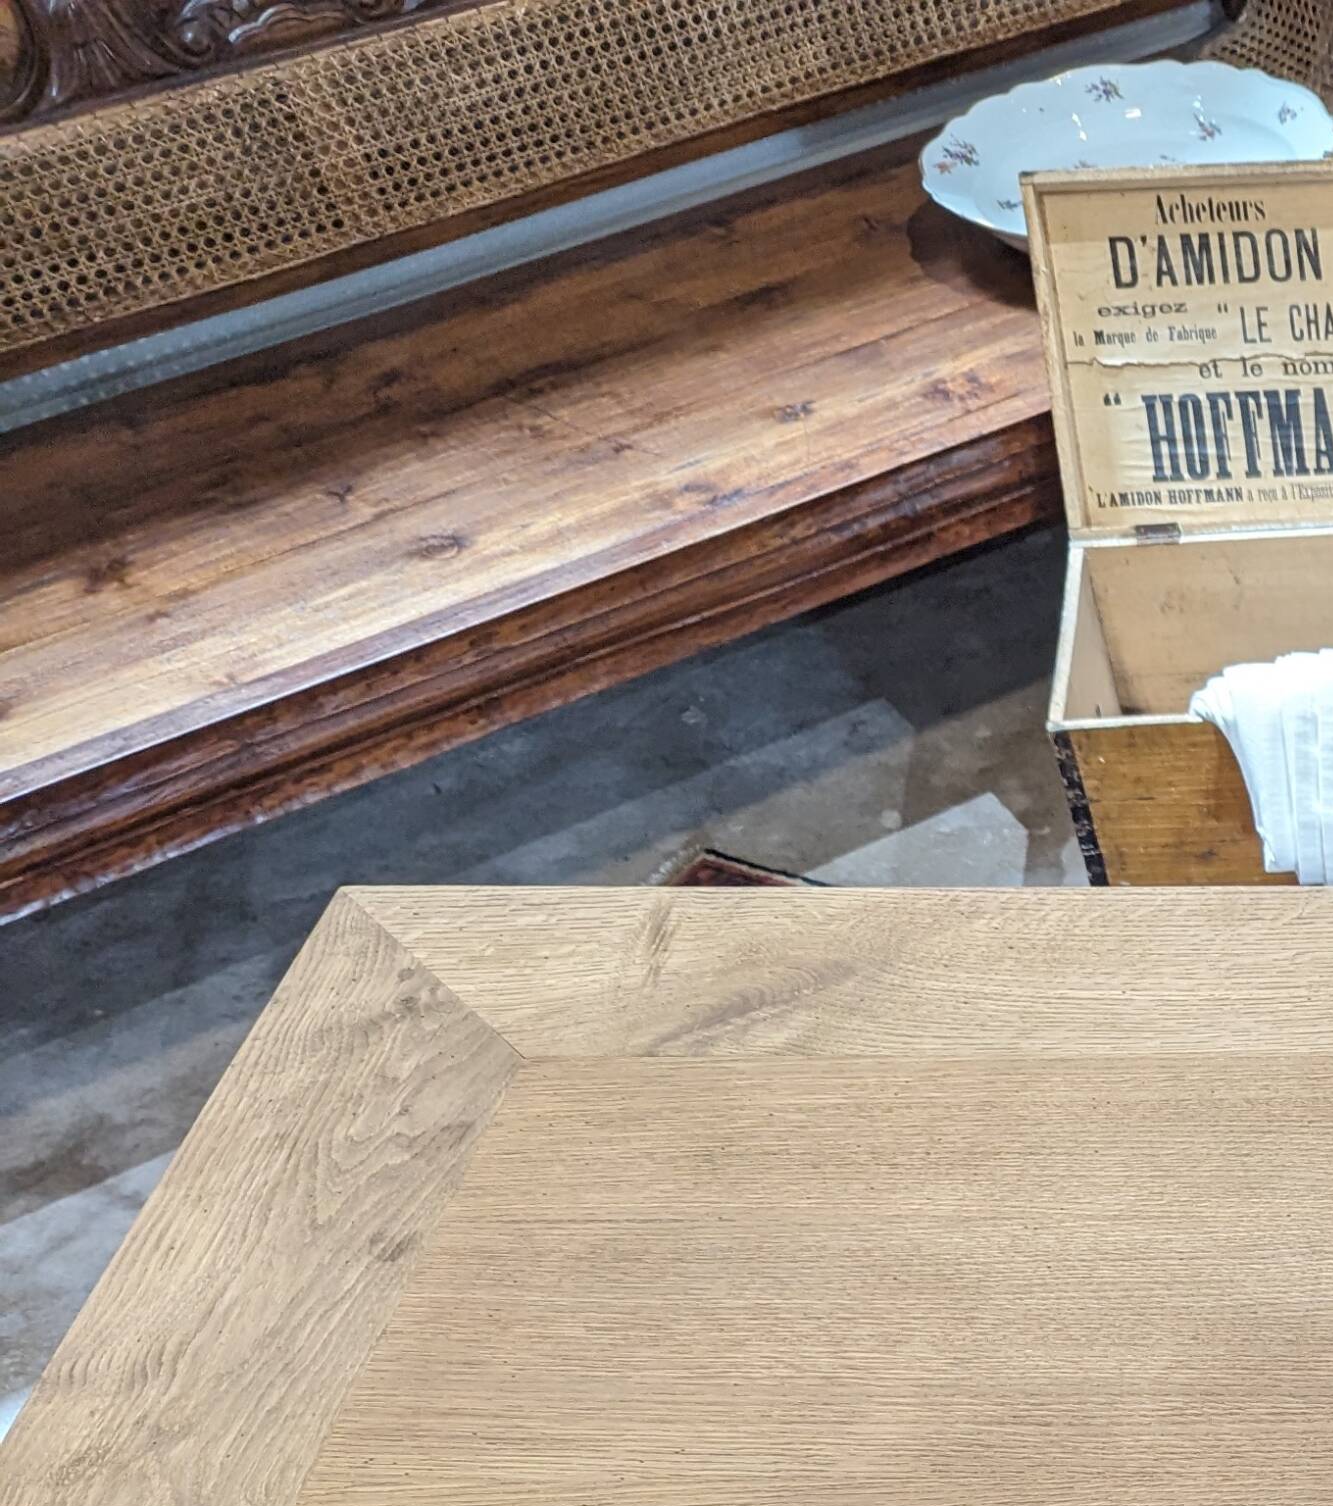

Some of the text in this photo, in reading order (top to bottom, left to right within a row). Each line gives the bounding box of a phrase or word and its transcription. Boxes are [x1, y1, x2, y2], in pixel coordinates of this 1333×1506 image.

[1155, 194, 1267, 225] Acheteurs
[1108, 227, 1323, 290] D'AMIDON
[1097, 301, 1188, 318] exigez
[1094, 329, 1137, 348] Marque
[1168, 324, 1217, 344] Fabrique
[1199, 360, 1222, 380] et
[1242, 357, 1263, 378] le
[1096, 491, 1163, 508] L'AMIDON
[1168, 487, 1244, 505] HOFFMANN
